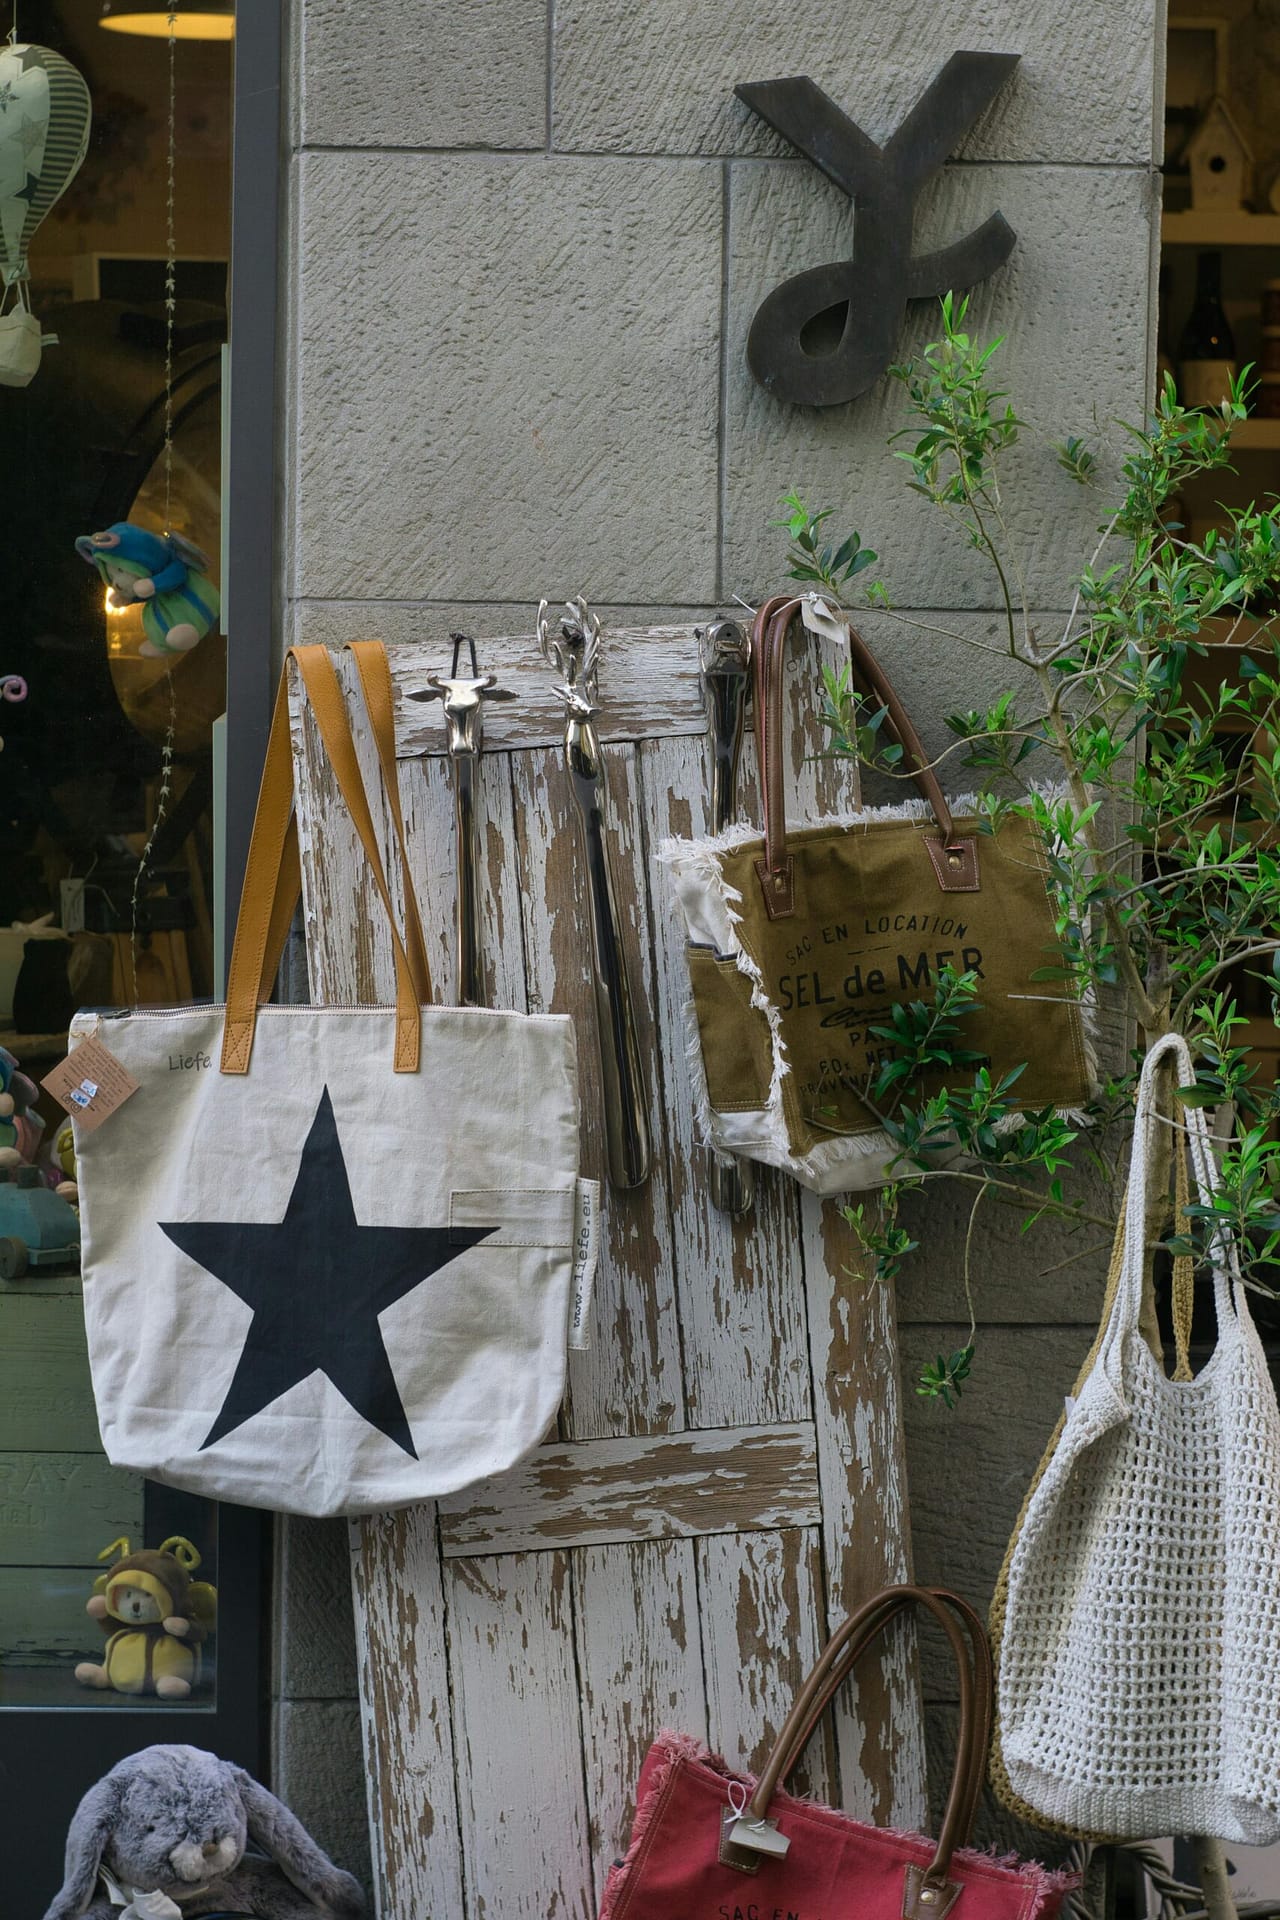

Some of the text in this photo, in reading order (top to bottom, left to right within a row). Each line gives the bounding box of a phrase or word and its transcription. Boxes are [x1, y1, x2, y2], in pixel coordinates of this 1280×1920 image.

[786, 915, 969, 967] SAC EN LOCATION
[779, 947, 986, 1011] SEL de MER
[573, 1193, 592, 1329] www.liefe.eu
[718, 1904, 759, 1920] SAC
